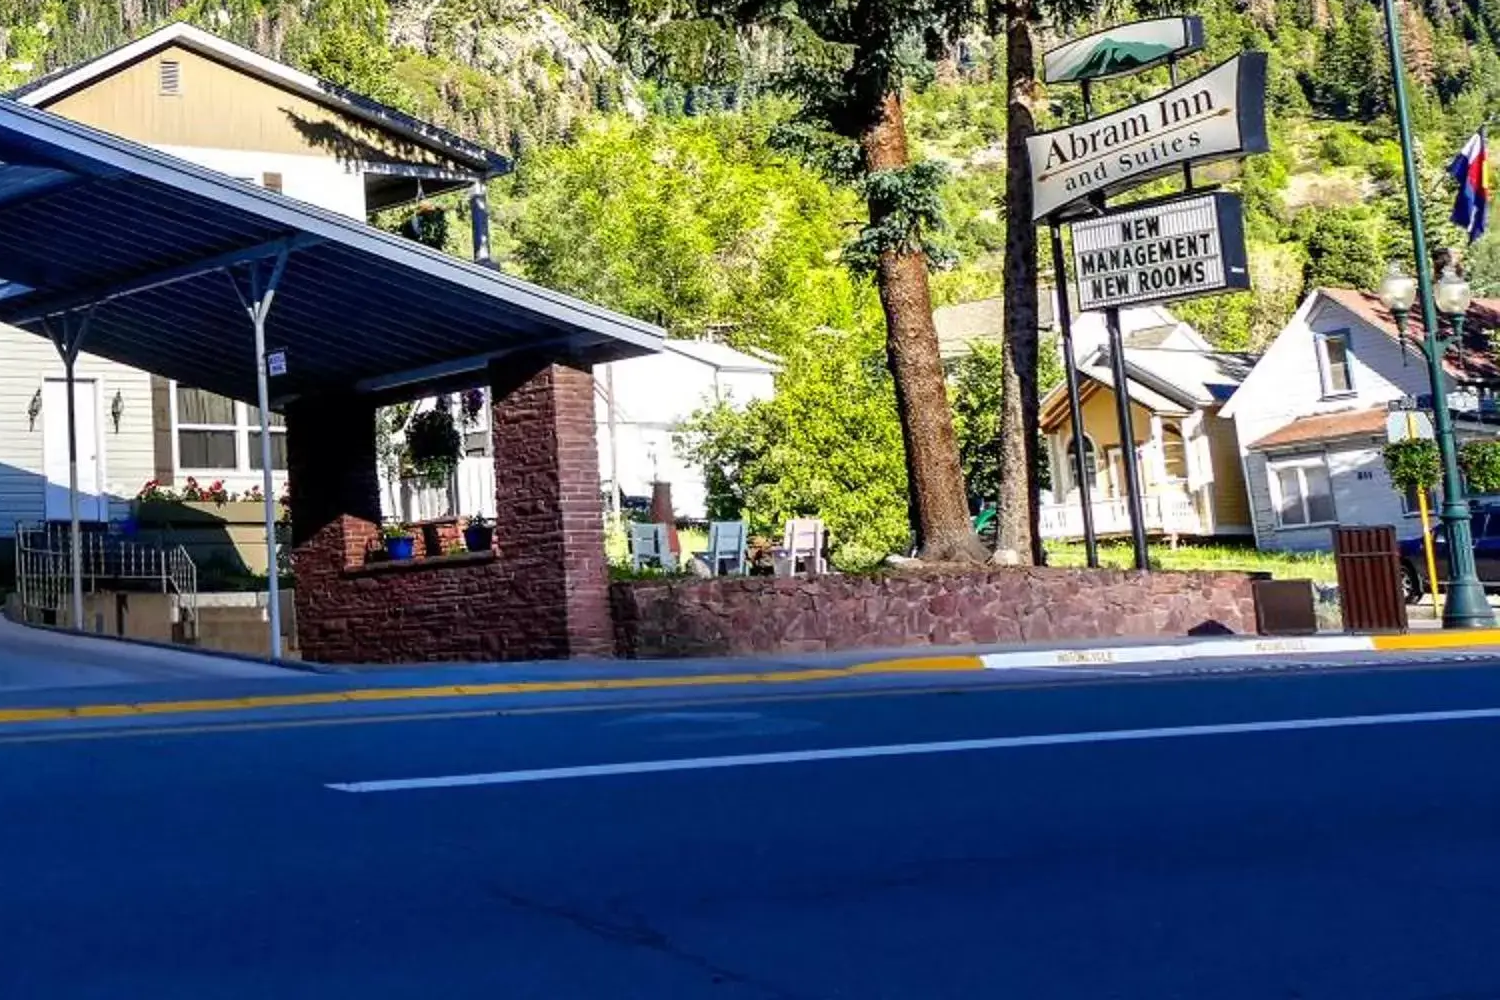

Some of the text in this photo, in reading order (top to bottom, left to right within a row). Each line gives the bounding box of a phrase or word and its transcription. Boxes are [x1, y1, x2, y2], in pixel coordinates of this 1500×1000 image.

[1045, 88, 1214, 170] Abram Inn
[1064, 129, 1202, 191] and Suites
[1121, 216, 1160, 242] NEW
[1081, 233, 1210, 276] MANAGEMENT
[1092, 261, 1205, 299] NEW ROOMS
